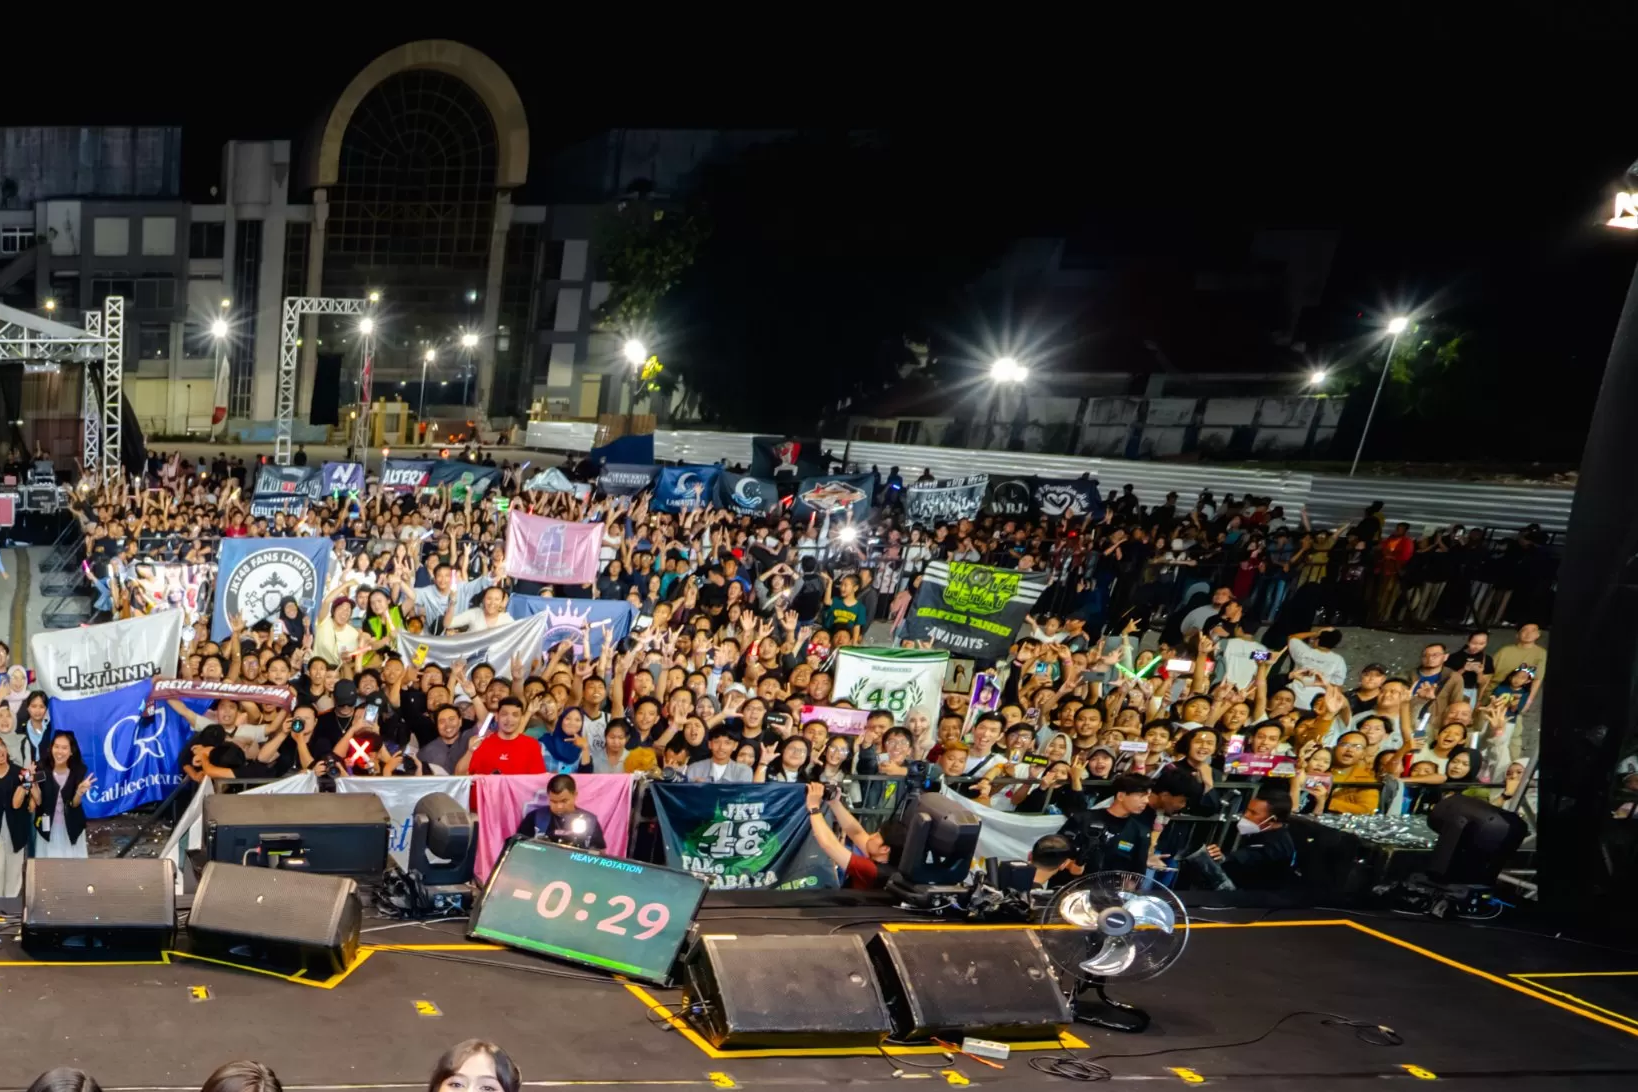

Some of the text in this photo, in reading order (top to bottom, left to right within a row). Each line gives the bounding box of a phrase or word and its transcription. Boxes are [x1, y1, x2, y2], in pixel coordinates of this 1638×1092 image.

[229, 564, 251, 593] JKT48
[250, 552, 279, 569] FANS
[155, 679, 290, 700] FREYA JAYAWARDANA
[866, 688, 907, 712] 48
[722, 802, 765, 821] JKT
[698, 820, 772, 859] 48
[570, 852, 644, 874] HEAVY ROTATION
